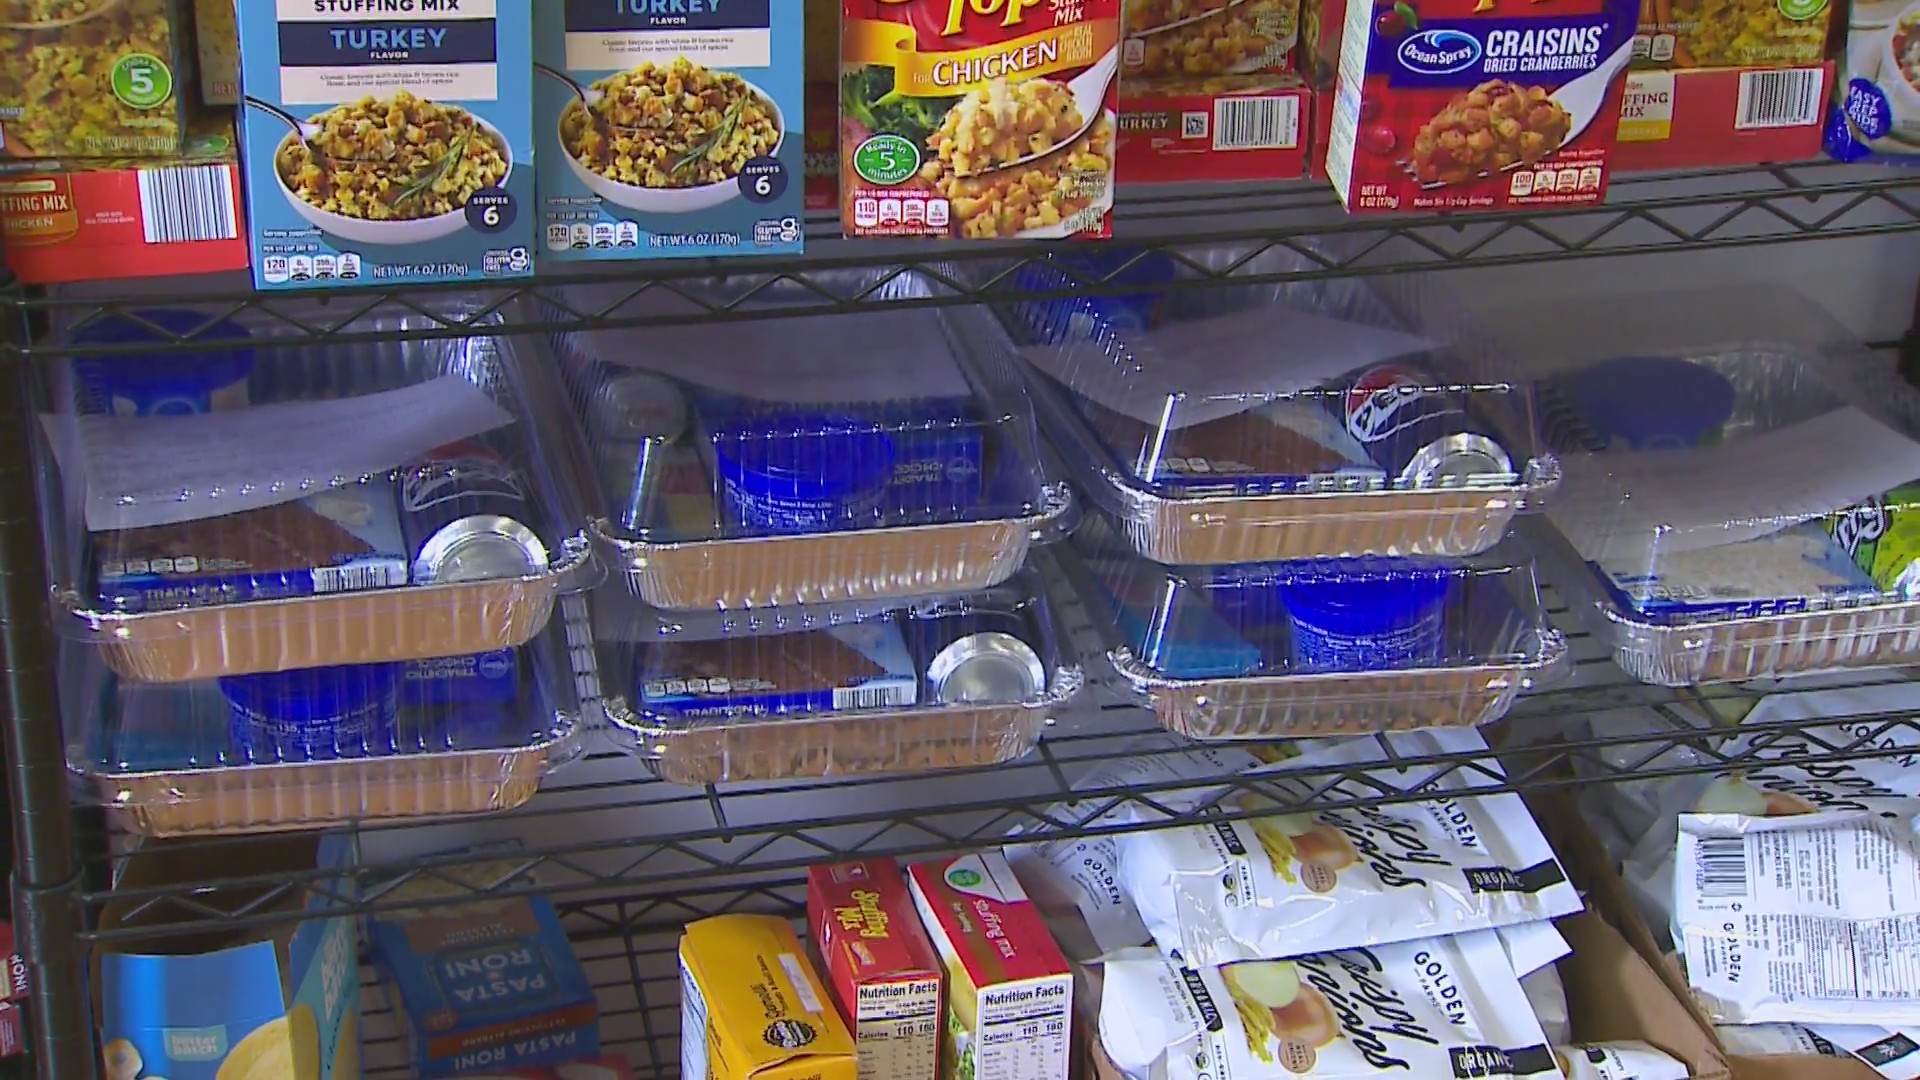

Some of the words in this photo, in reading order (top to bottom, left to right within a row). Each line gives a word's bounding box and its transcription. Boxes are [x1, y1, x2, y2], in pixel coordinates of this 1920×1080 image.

[421, 0, 459, 11] MIX
[650, 17, 687, 26] FLAVOR
[330, 28, 447, 50] TURKEY
[1486, 26, 1601, 57] CRAISINS
[370, 51, 409, 60] FLAVOR
[1404, 43, 1437, 64] Ocean
[1438, 46, 1472, 65] Spray
[932, 38, 1059, 87] CHICKEN
[1483, 58, 1518, 74] DRIED
[1520, 54, 1597, 72] CRANBERRIES
[130, 69, 154, 94] 5
[865, 138, 894, 154] Ready
[879, 153, 896, 169] 5
[746, 166, 780, 174] SERVES
[868, 168, 908, 180] minutes
[755, 176, 771, 195] 6
[1516, 174, 1531, 184] 100
[43, 195, 69, 210] MIX
[473, 197, 509, 206] SERVES
[858, 202, 875, 212] 110
[483, 206, 499, 226] 6
[651, 235, 668, 246] NET
[688, 235, 694, 245] 6
[697, 234, 709, 245] OZ
[712, 233, 740, 246] (170g)
[267, 260, 285, 270] 120
[373, 266, 393, 278] NET
[395, 266, 412, 277] WT
[413, 265, 420, 276] 6
[422, 264, 436, 276] OZ
[438, 264, 469, 277] (170g)
[446, 948, 532, 978] RONI
[456, 974, 546, 1002] PASTA
[859, 983, 906, 999] Nutrition
[908, 981, 937, 994] Facts
[985, 990, 1032, 1006] Nutrition
[1035, 984, 1064, 998] Facts
[1414, 951, 1466, 1025] GOLDEN
[858, 1031, 888, 1040] Calories
[897, 1026, 914, 1037] 110
[984, 1032, 1013, 1042] Calories
[1023, 1026, 1038, 1036] 110
[514, 1031, 576, 1055] PASTA
[455, 1047, 505, 1071] RONI
